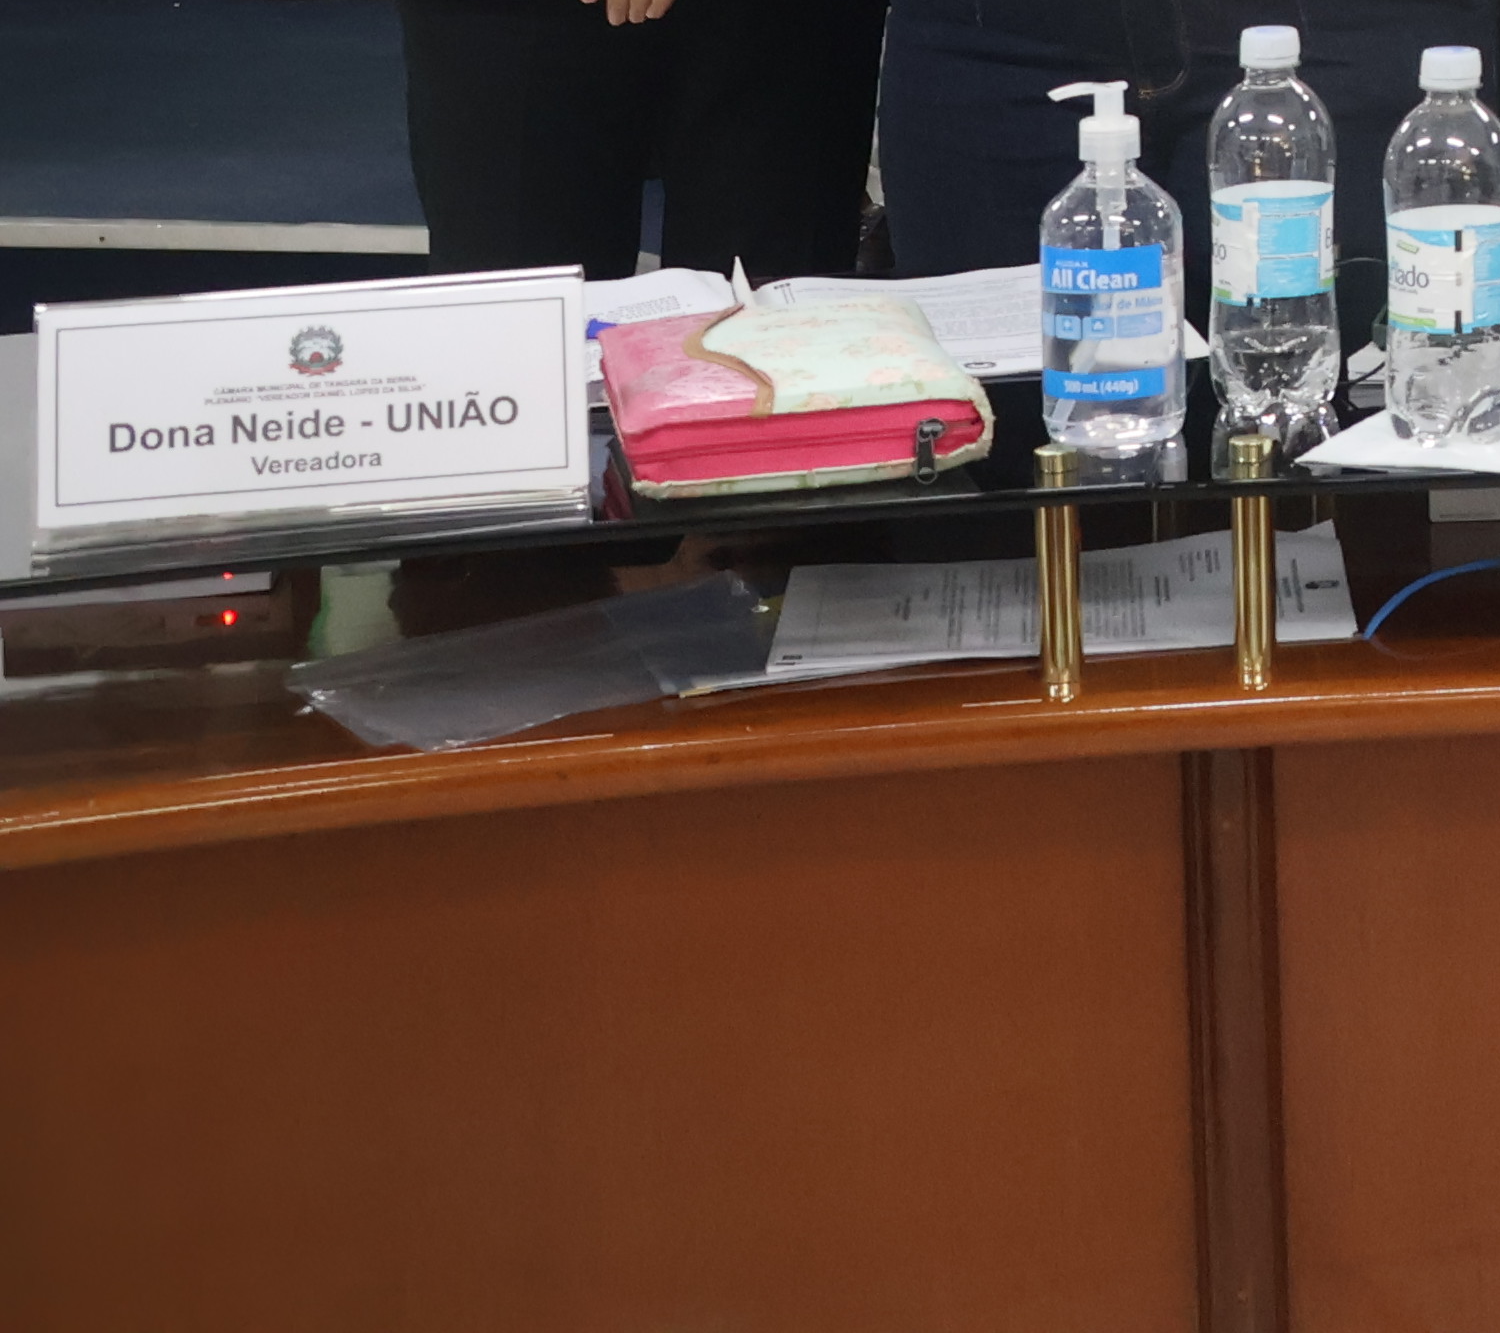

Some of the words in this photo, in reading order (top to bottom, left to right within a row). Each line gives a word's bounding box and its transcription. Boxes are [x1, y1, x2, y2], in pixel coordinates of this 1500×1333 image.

[1051, 268, 1073, 290] All
[1077, 269, 1138, 290] Clean
[109, 419, 215, 455] Dona
[232, 411, 346, 446] Neide
[388, 391, 519, 434] UNIÃO
[251, 449, 382, 477] Vereadora
